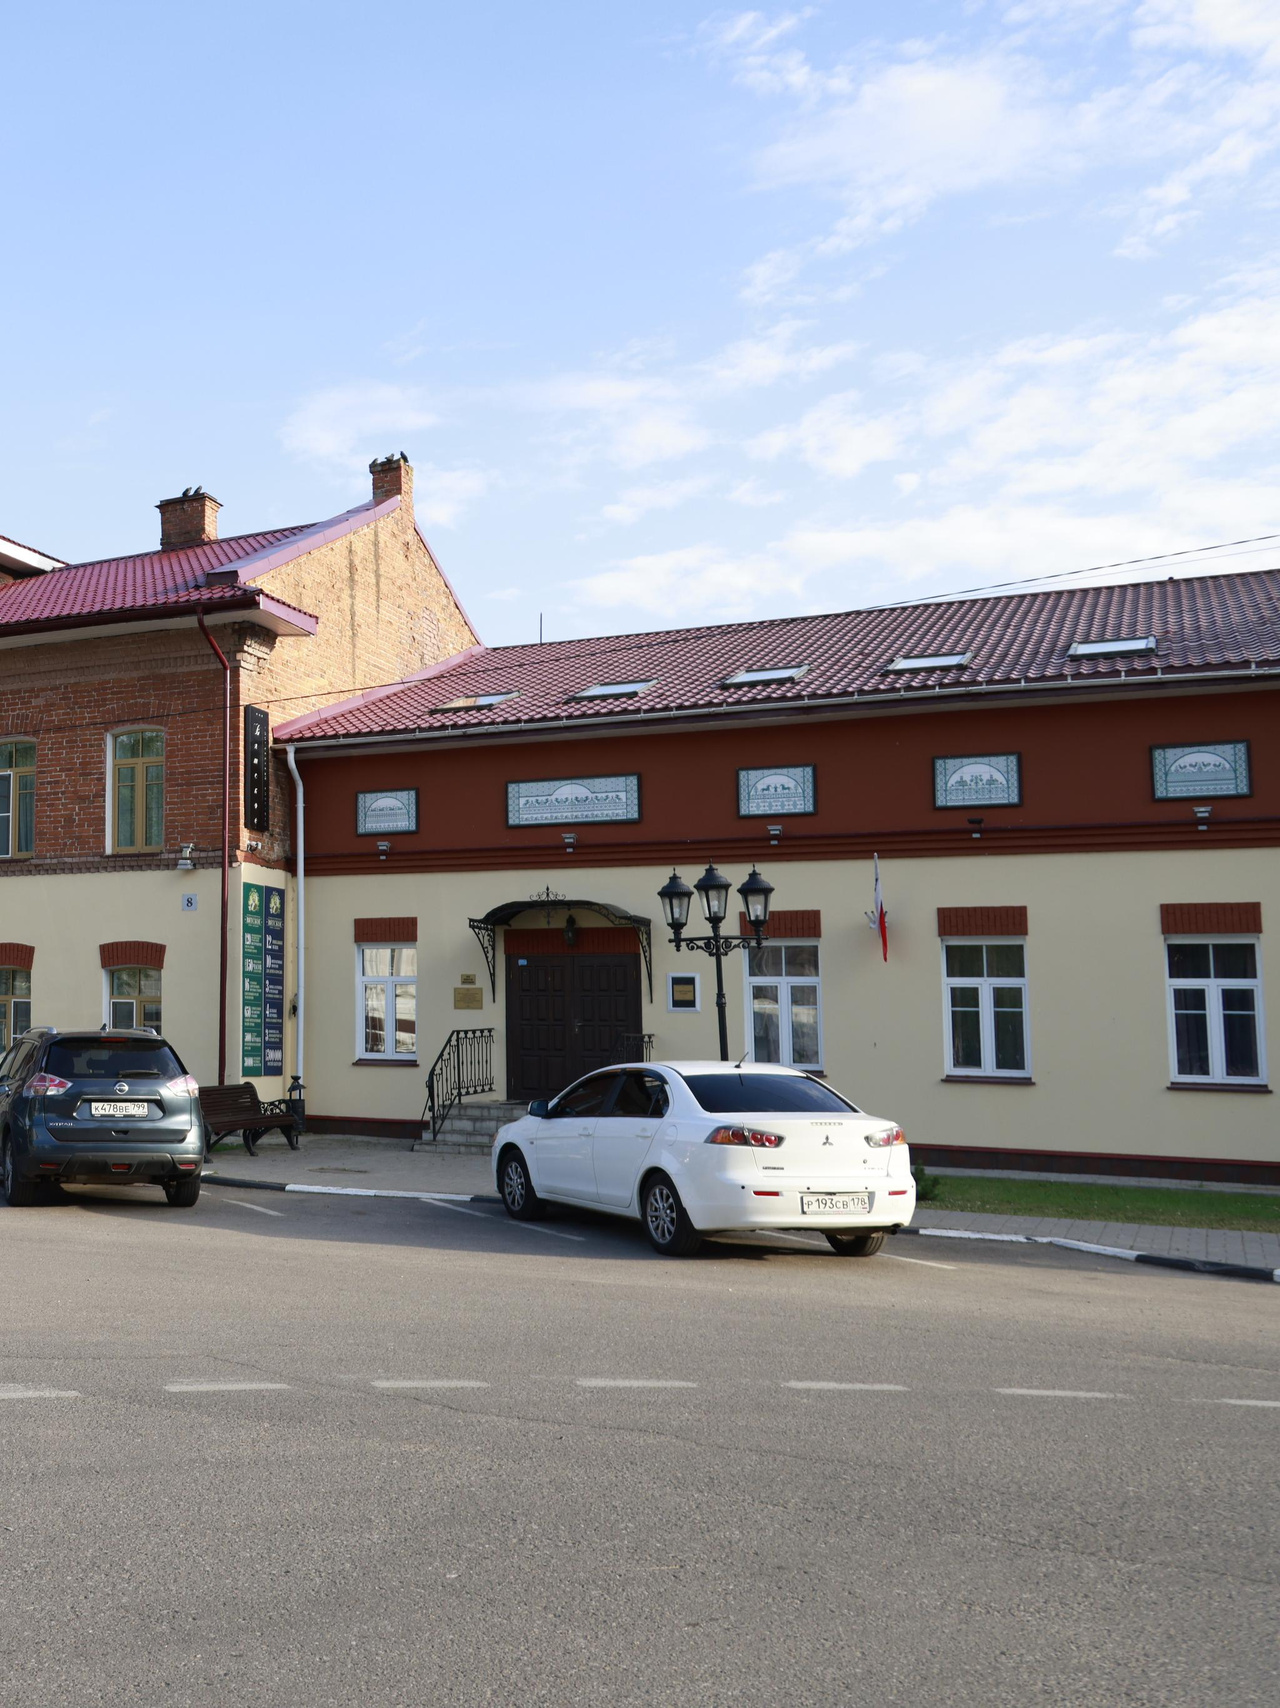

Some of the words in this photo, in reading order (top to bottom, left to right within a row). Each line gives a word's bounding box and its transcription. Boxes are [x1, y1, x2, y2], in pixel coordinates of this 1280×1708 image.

[186, 896, 194, 908] 8
[94, 1103, 130, 1113] К478ВЕ
[807, 1198, 849, 1210] Р193СВ
[851, 1198, 866, 1207] 178
